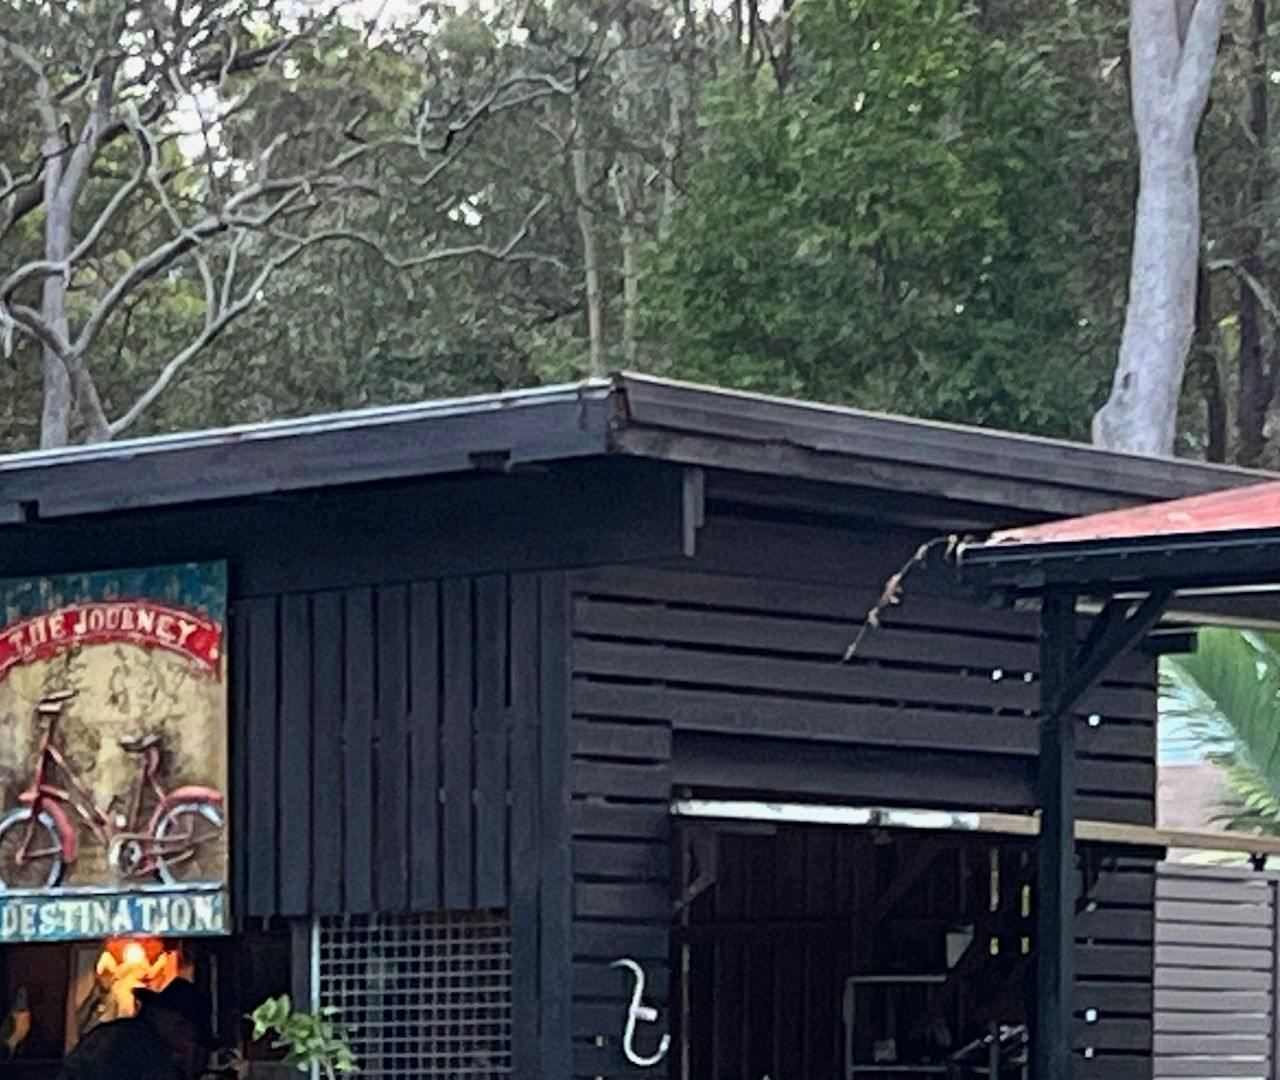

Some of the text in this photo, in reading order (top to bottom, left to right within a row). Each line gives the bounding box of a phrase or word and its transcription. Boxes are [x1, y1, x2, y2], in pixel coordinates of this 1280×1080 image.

[8, 606, 197, 652] THE JOURNEY
[0, 895, 216, 939] DESTINATION
